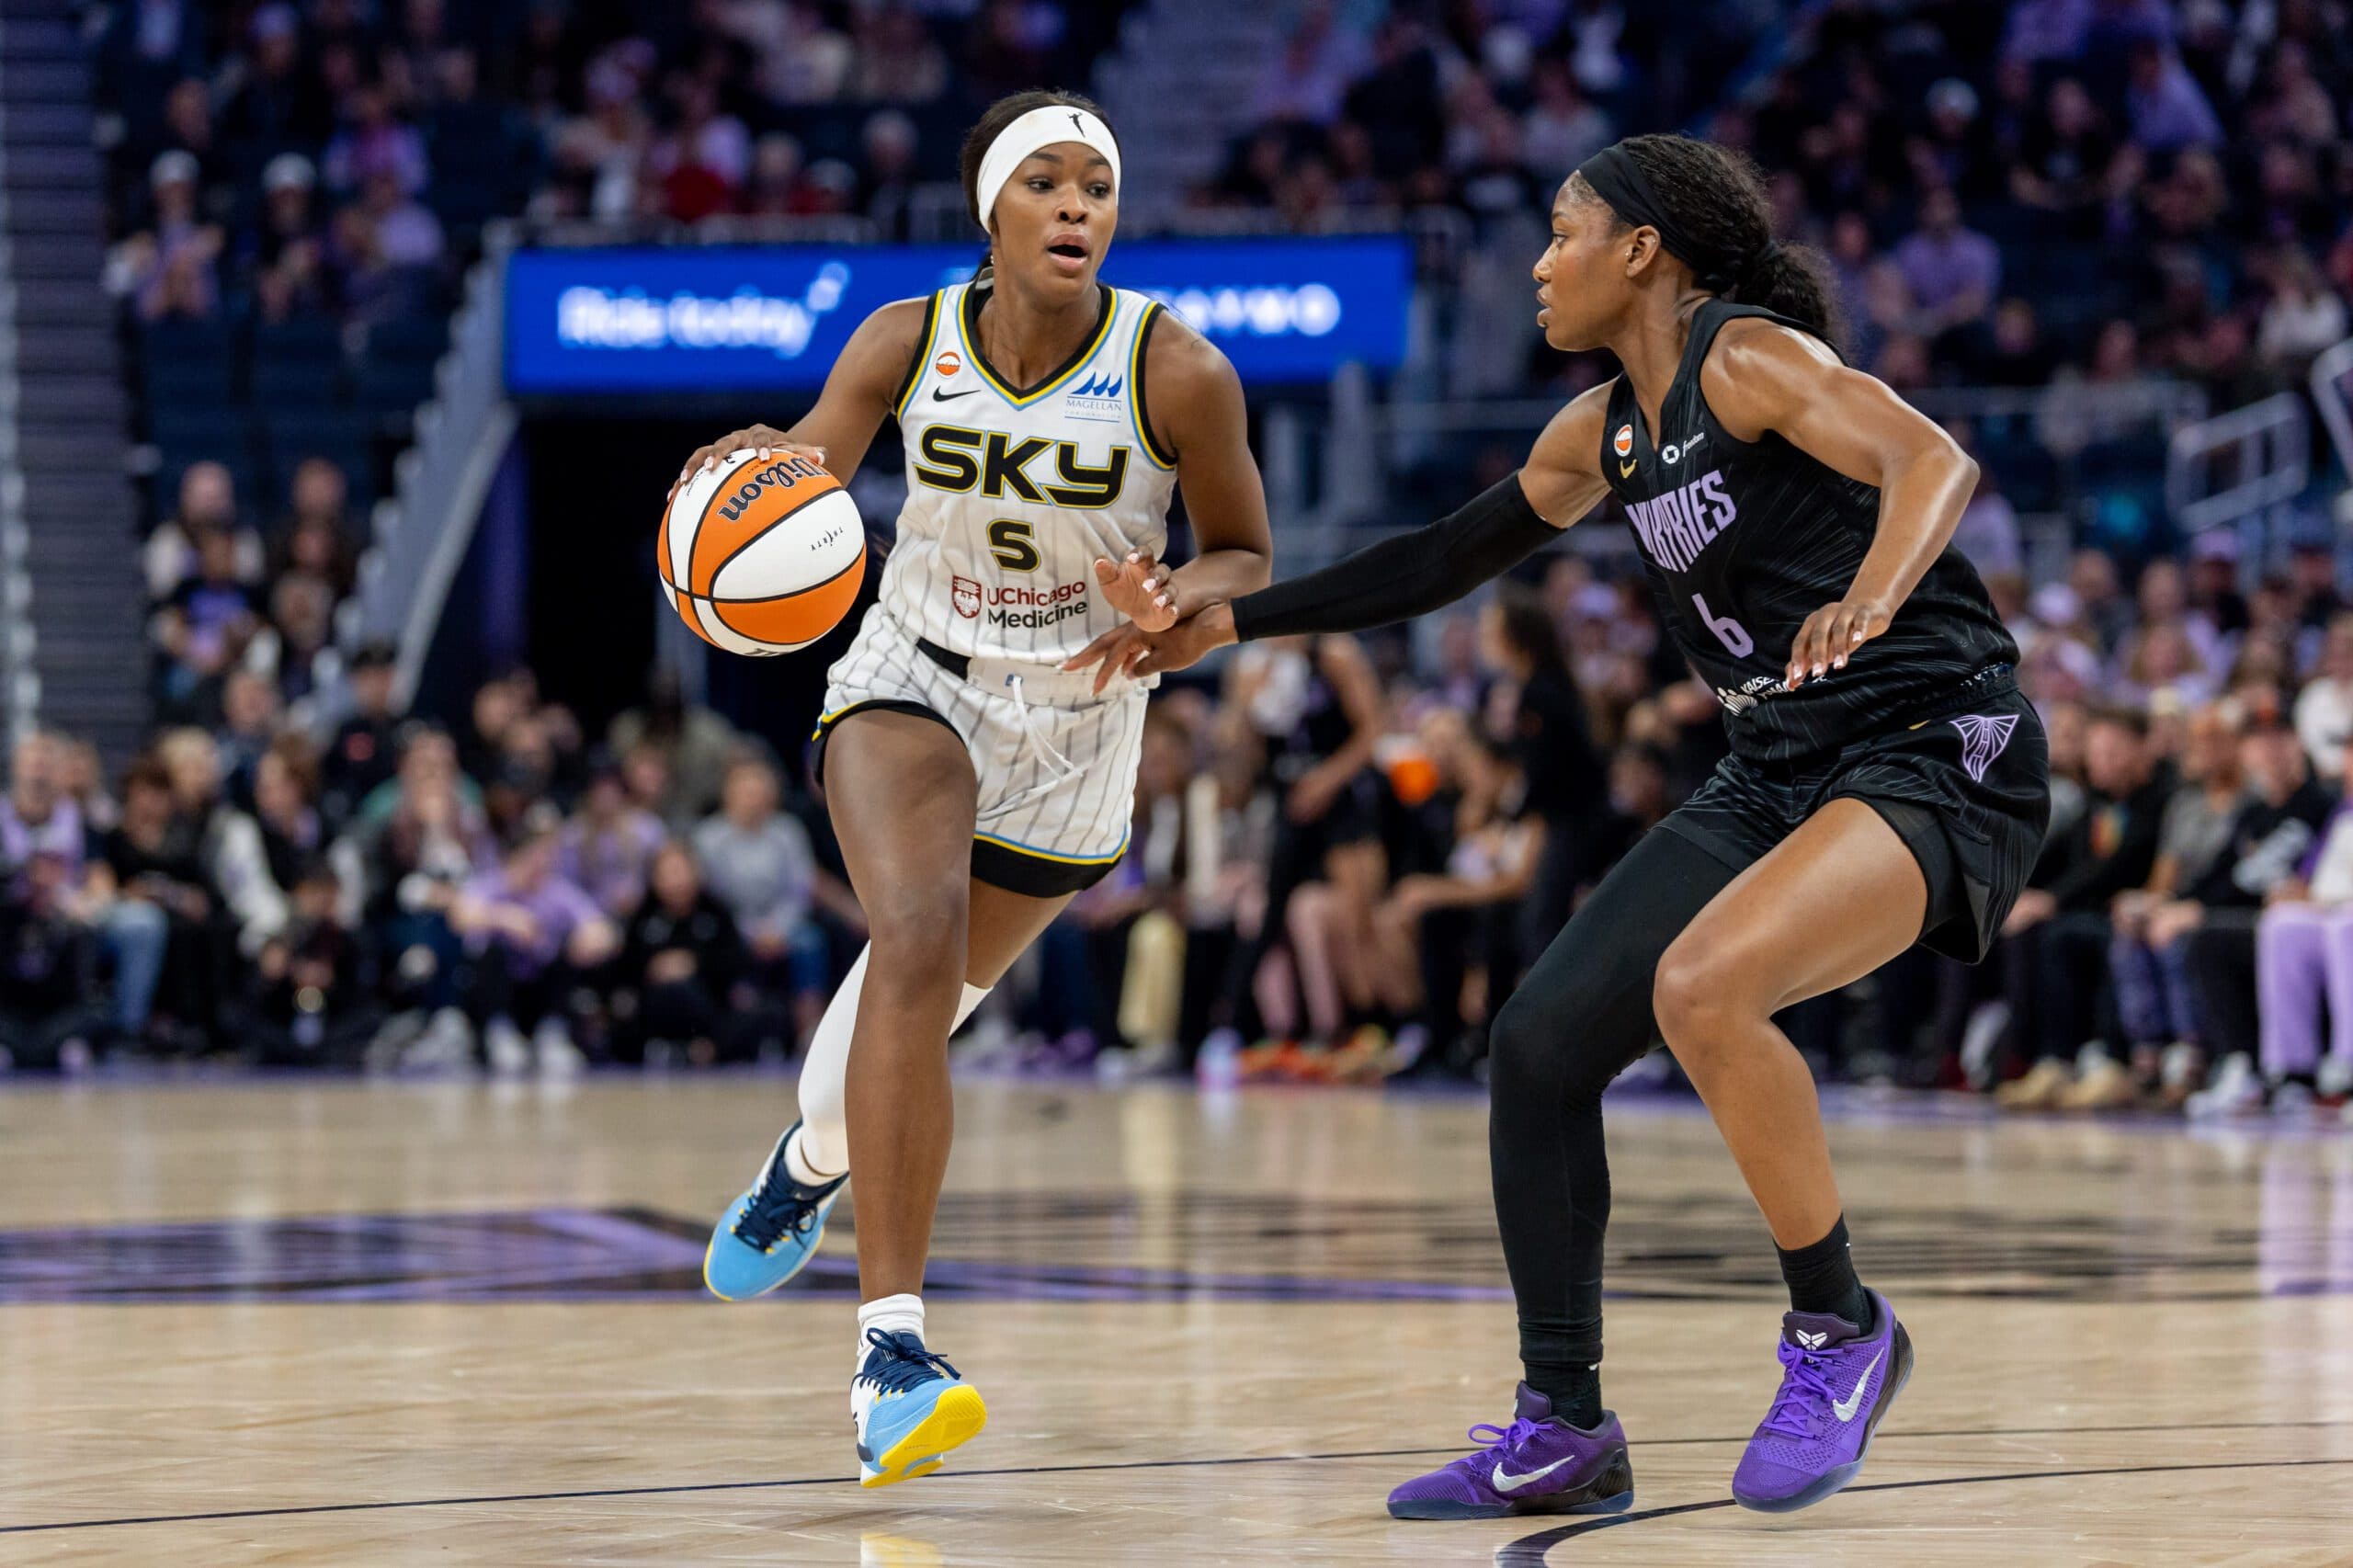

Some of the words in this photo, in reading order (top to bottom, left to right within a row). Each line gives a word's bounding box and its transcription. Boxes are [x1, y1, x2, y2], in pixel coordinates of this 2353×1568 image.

[1065, 399, 1122, 412] MAGELLAN
[913, 423, 1131, 510] SKY
[718, 456, 831, 522] Wilson
[987, 581, 1086, 607] UChicago
[987, 601, 1087, 629] Medicine
[1691, 593, 1754, 659] 6
[1740, 676, 1779, 695] KAISE
